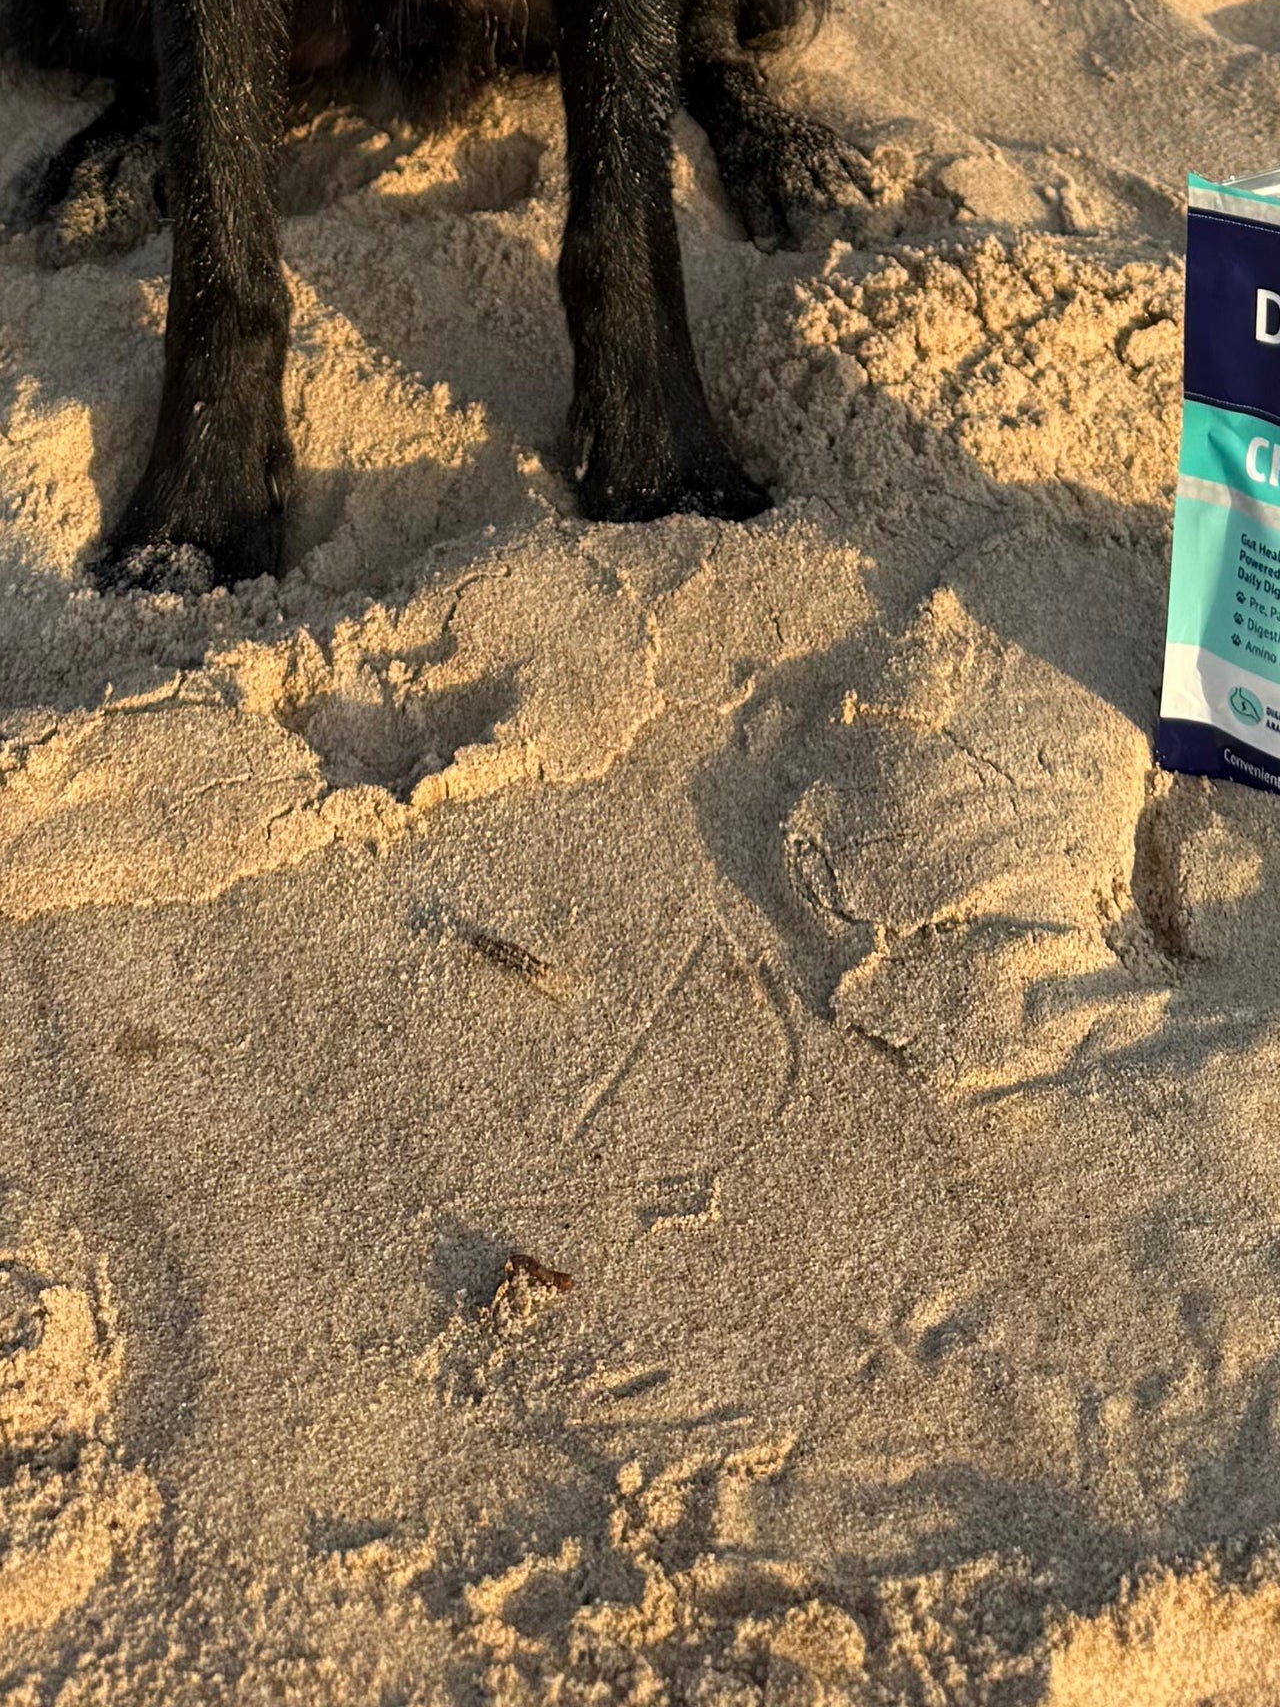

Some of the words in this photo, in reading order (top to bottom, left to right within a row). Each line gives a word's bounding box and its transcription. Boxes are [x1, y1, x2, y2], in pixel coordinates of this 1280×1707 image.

[1241, 533, 1256, 551] Gut
[1239, 549, 1280, 580] Powered
[1238, 565, 1262, 591] Daily
[1249, 596, 1268, 617] Pre,
[1245, 640, 1277, 664] Amino
